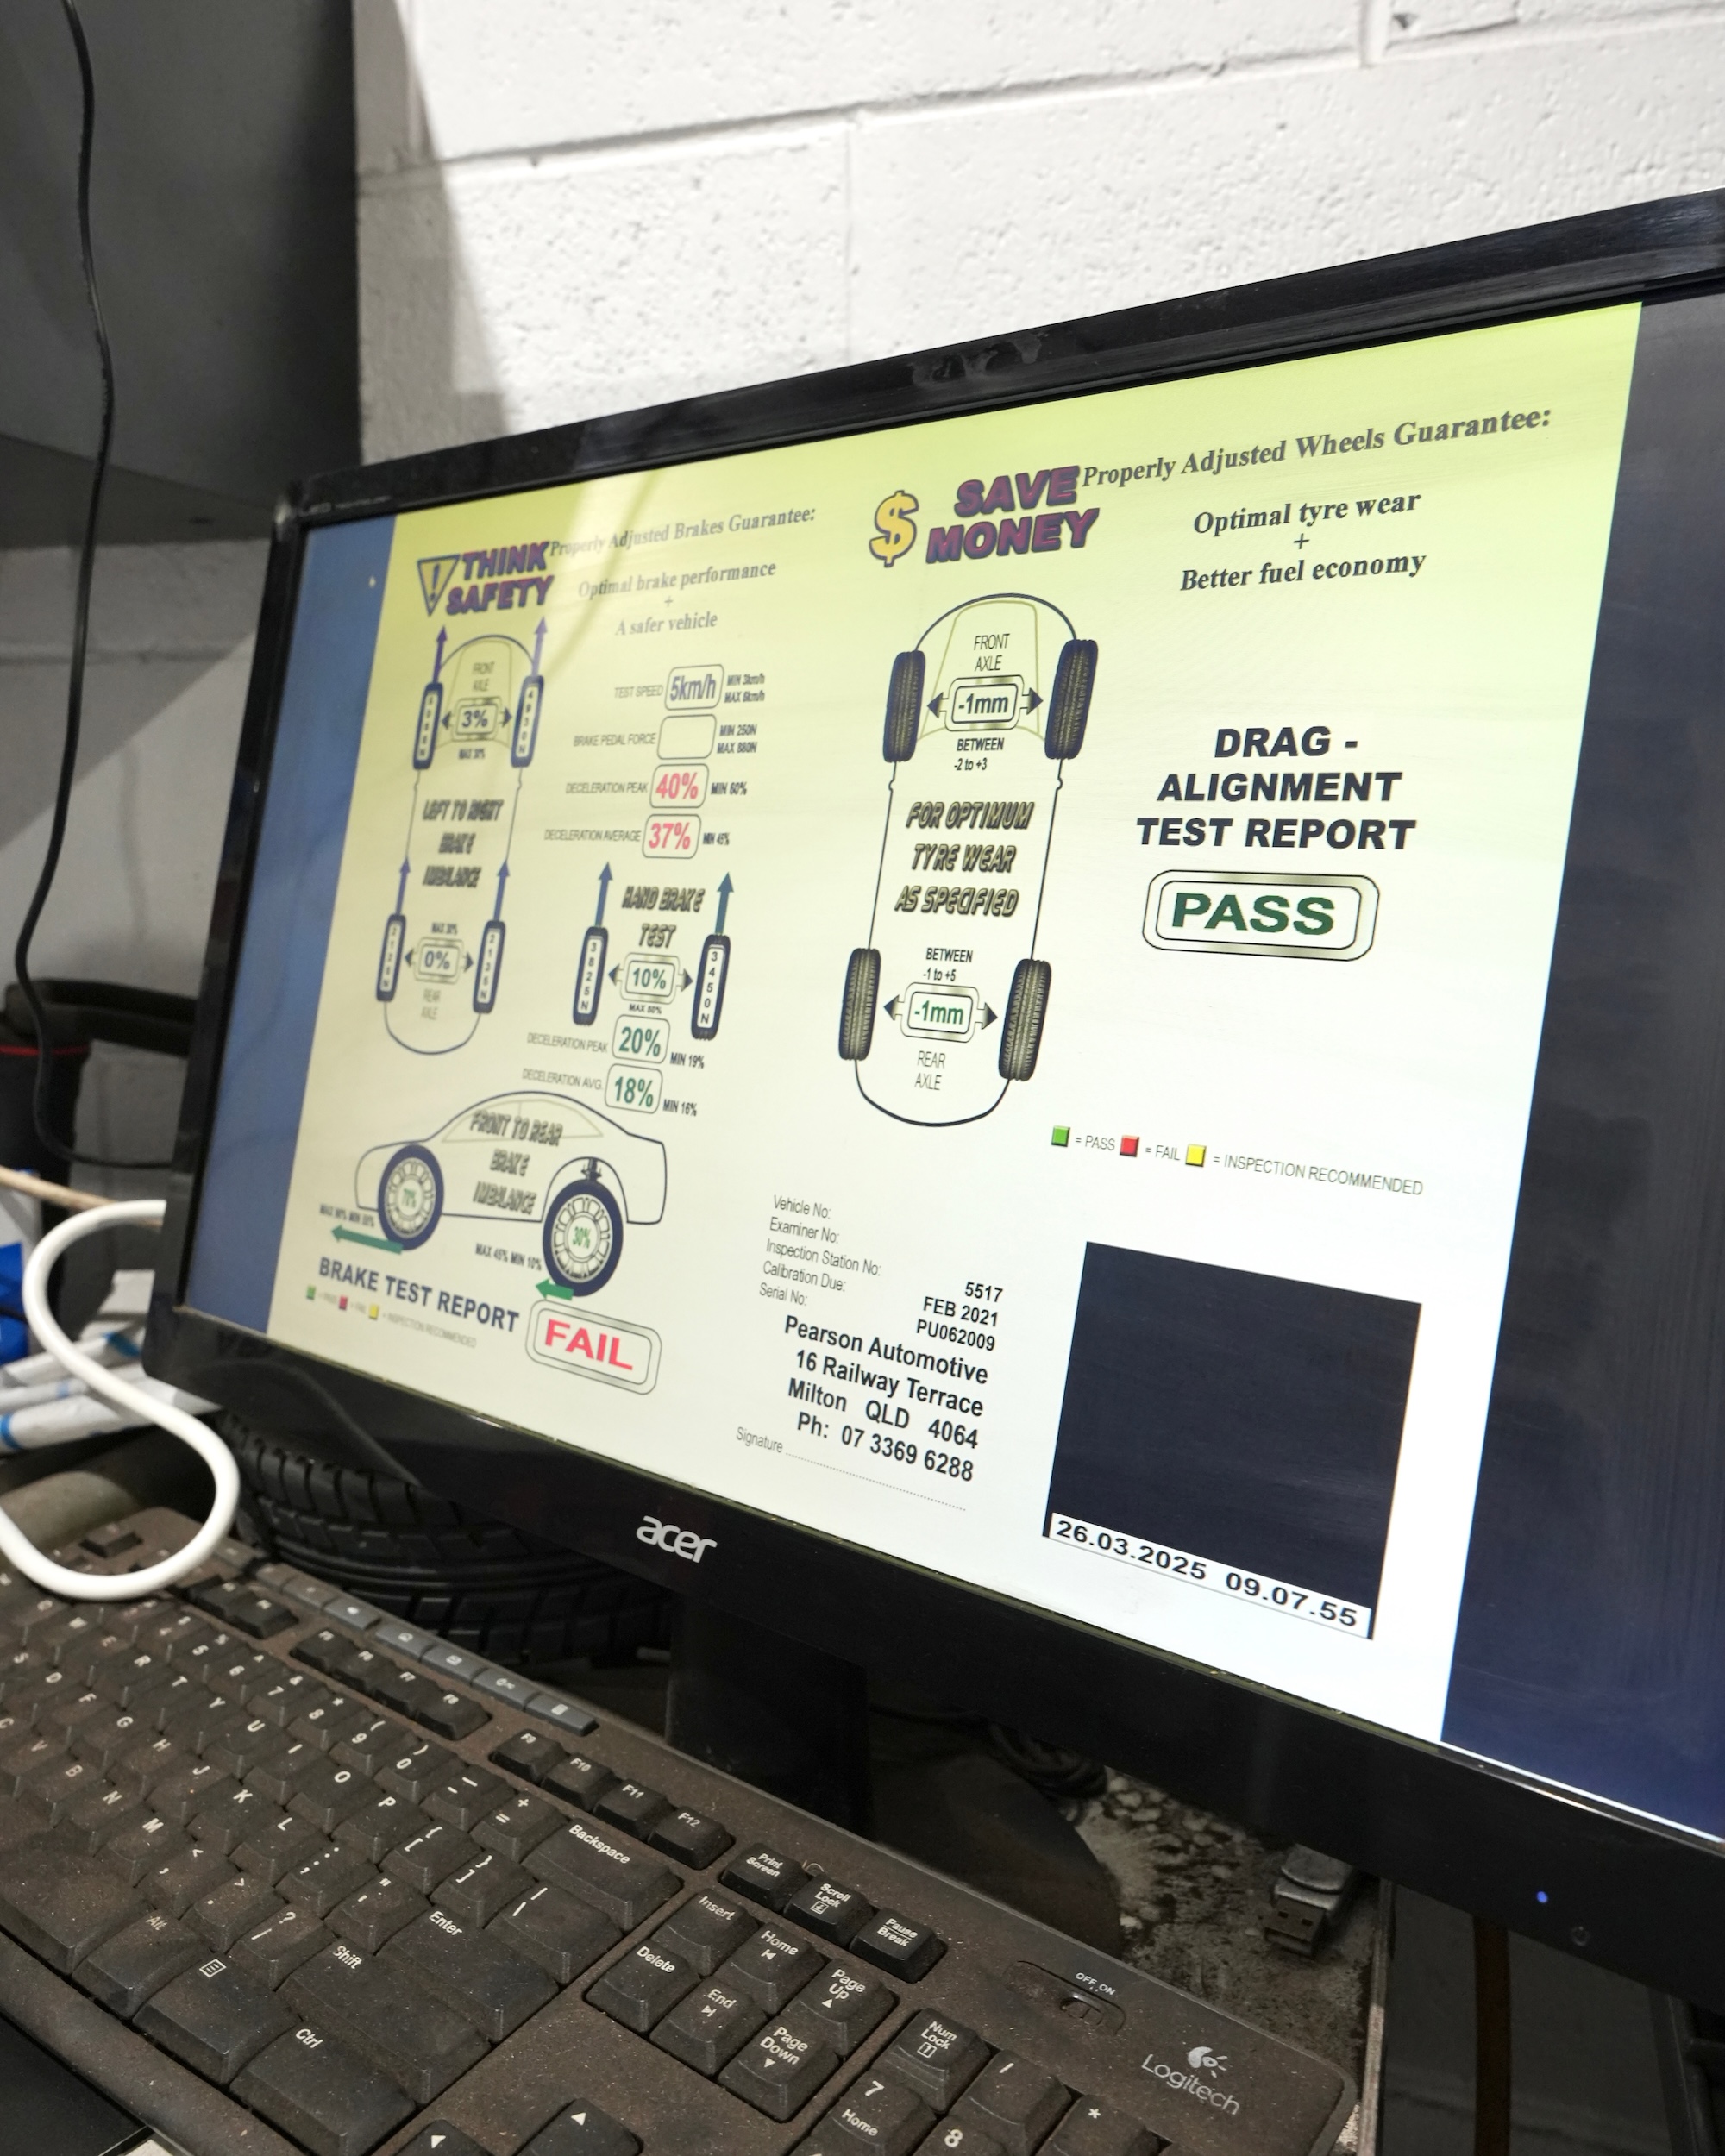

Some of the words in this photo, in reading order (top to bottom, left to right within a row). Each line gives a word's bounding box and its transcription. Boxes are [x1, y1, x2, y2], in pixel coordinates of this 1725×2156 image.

[1082, 457, 1176, 488] Properly
[1181, 440, 1287, 475] Adjusted
[1296, 429, 1385, 458] Wheels
[1394, 409, 1551, 446] Guarantee:
[954, 465, 1080, 517] SAVE
[1194, 503, 1291, 536] Optimal
[1299, 503, 1348, 527] tyre
[1356, 494, 1421, 517] wear
[550, 535, 605, 557] Properly
[609, 524, 669, 549] Adjusted
[674, 518, 724, 540] Brakes
[729, 508, 816, 532] Guarantee:
[925, 508, 1100, 564] MONEY
[461, 541, 550, 581] THINK
[1180, 569, 1253, 591] Better
[1259, 560, 1305, 584] fuel
[1313, 555, 1427, 578] economy
[579, 575, 632, 600] Optimal
[637, 572, 677, 592] brake
[681, 562, 776, 590] performance
[446, 575, 555, 616] SAFETY
[630, 617, 664, 635] safer
[668, 611, 718, 631] vehicle
[974, 633, 1010, 651] FRONT
[975, 655, 1002, 672] AXLE
[614, 687, 634, 698] TEST
[636, 685, 663, 697] SPEED
[670, 674, 716, 701] 5km/h
[959, 693, 1008, 714] -1mm
[461, 710, 489, 728] 3%
[574, 736, 599, 747] BRAKE
[601, 734, 626, 746] PEDAL
[628, 733, 656, 744] FORCE
[717, 743, 735, 754] MAX
[957, 737, 1004, 751] BETWEEN
[1214, 726, 1331, 758] DRAG
[954, 759, 963, 771] -2
[964, 758, 974, 770] to
[975, 758, 988, 770] +3
[566, 782, 625, 793] DECELERATION
[626, 782, 649, 793] PEAK
[656, 772, 699, 799] 40%
[711, 782, 727, 794] MIN
[729, 781, 747, 795] 60%
[1157, 772, 1402, 802] ALIGNMENT
[906, 801, 944, 828] FOR
[945, 801, 1035, 830] OPTIMUM
[544, 829, 603, 841] DECELERATION
[604, 830, 642, 842] AVERAGE
[649, 822, 691, 849] 37%
[1137, 818, 1233, 847] TEST
[1245, 818, 1417, 849] REPORT
[912, 843, 960, 870] TYRE
[962, 844, 1016, 873] WEAR
[622, 886, 658, 910] HAND
[659, 887, 706, 912] BRAKE
[894, 885, 921, 912] AS
[921, 887, 1019, 917] SPECIFIED
[1171, 892, 1335, 935] PASS
[638, 924, 676, 949] TEST
[424, 950, 450, 970] 0%
[925, 947, 973, 963] BETWEEN
[632, 968, 666, 990] 10%
[933, 968, 943, 981] to
[945, 969, 957, 982] +5
[630, 1004, 644, 1012] MAX
[914, 1000, 963, 1025] -1mm
[527, 1032, 585, 1050] DECELERATION
[586, 1040, 608, 1053] PEAK
[619, 1026, 661, 1057] 20%
[670, 1052, 686, 1065] MIN
[688, 1054, 705, 1069] 19%
[918, 1050, 945, 1069] REAR
[523, 1068, 580, 1087] DECELERATION
[914, 1073, 942, 1091] AXLE
[615, 1075, 654, 1108] 18%
[663, 1099, 679, 1112] MIN
[681, 1100, 697, 1117] 16%
[470, 1109, 511, 1136] FRONT
[511, 1115, 530, 1140] TO
[529, 1119, 563, 1147] REAR
[490, 1148, 530, 1176] BRAKE
[1084, 1134, 1115, 1151] PASS
[1155, 1144, 1181, 1162] FAIL
[1223, 1154, 1305, 1180] INSPECTION
[1308, 1166, 1423, 1196] RECOMMENDED
[774, 1194, 810, 1216] Vehicle
[812, 1202, 831, 1219] No:
[573, 1226, 591, 1249] 30%
[769, 1217, 819, 1240] Examiner
[820, 1227, 840, 1244] No:
[475, 1243, 492, 1257] MAX
[511, 1252, 524, 1266] MIN
[527, 1256, 542, 1271] 10%
[766, 1238, 819, 1264] Inspection
[821, 1250, 859, 1272] Station
[862, 1259, 881, 1276] No:
[762, 1260, 818, 1286] Calibration
[820, 1273, 846, 1293] Due:
[318, 1257, 380, 1292] BRAKE
[386, 1275, 433, 1307] TEST
[437, 1291, 519, 1332] REPORT
[759, 1282, 787, 1303] Serial
[790, 1289, 807, 1307] No:
[965, 1281, 1003, 1303] 5517
[923, 1296, 956, 1318] FEB
[961, 1305, 998, 1327] 2021
[545, 1318, 633, 1371] FAIL
[916, 1319, 995, 1351] PU062009
[784, 1314, 863, 1352] Pearson
[868, 1337, 988, 1385] Automotive
[796, 1349, 817, 1371] 16
[823, 1356, 900, 1398] Railway
[907, 1377, 984, 1417] Terrace
[787, 1377, 847, 1412] Milton
[866, 1399, 910, 1430] QLD
[928, 1419, 979, 1449] 4064
[736, 1426, 783, 1454] Signature
[798, 1411, 829, 1438] Ph:
[841, 1425, 865, 1449] 07
[870, 1432, 918, 1465] 3369
[924, 1449, 974, 1482] 6288
[636, 1515, 718, 1564] acer
[1057, 1520, 1207, 1580] 26.03.2025
[1226, 1571, 1357, 1627] 09.07.55
[520, 1732, 536, 1745] F9
[570, 1757, 592, 1773] F10
[622, 1783, 644, 1800] F11
[677, 1811, 700, 1828] F12
[568, 1824, 630, 1865] Backspace
[745, 1857, 781, 1878] Screen
[757, 1852, 784, 1870] Print
[813, 1890, 841, 1908] Lock
[819, 1883, 852, 1903] Scroll
[698, 1895, 736, 1921] Insert
[145, 1915, 169, 1932] Alt
[429, 1910, 463, 1937] Enter
[885, 1918, 918, 1939] Pause
[761, 1930, 799, 1956] Home
[876, 1927, 910, 1948] Break
[331, 1944, 362, 1970] Shift
[636, 1946, 676, 1974] Delete
[829, 1983, 850, 2001] Up
[831, 1969, 866, 1993] Page
[1076, 1972, 1097, 1987] OFF
[1099, 1984, 1116, 1996] ON
[707, 1989, 737, 2009] End
[294, 2028, 323, 2050] Ctrl
[774, 2027, 808, 2053] Page
[920, 2029, 951, 2051] Lock
[928, 2021, 958, 2041] Num
[759, 2037, 800, 2065] Down
[1141, 2053, 1240, 2115] Logitech
[841, 2109, 879, 2138] Home
